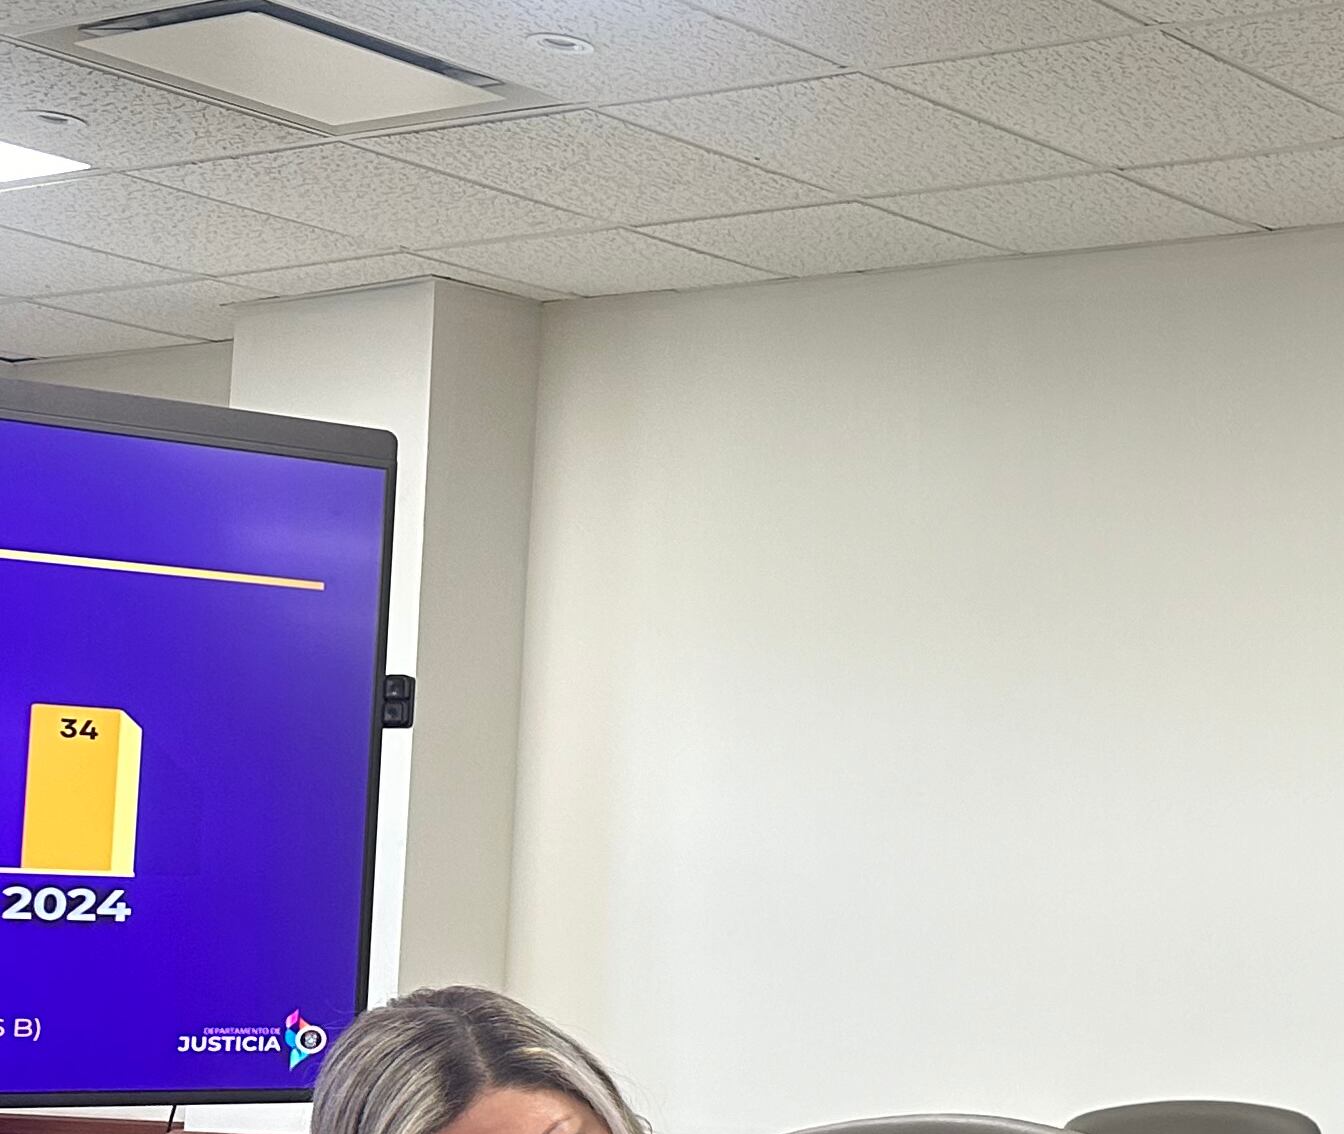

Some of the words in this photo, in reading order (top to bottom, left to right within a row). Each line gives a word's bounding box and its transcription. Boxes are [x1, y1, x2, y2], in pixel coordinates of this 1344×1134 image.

[60, 717, 99, 740] 34
[2, 885, 132, 922] 2024
[14, 1017, 41, 1042] B)
[177, 1035, 281, 1053] JUSTICIA
